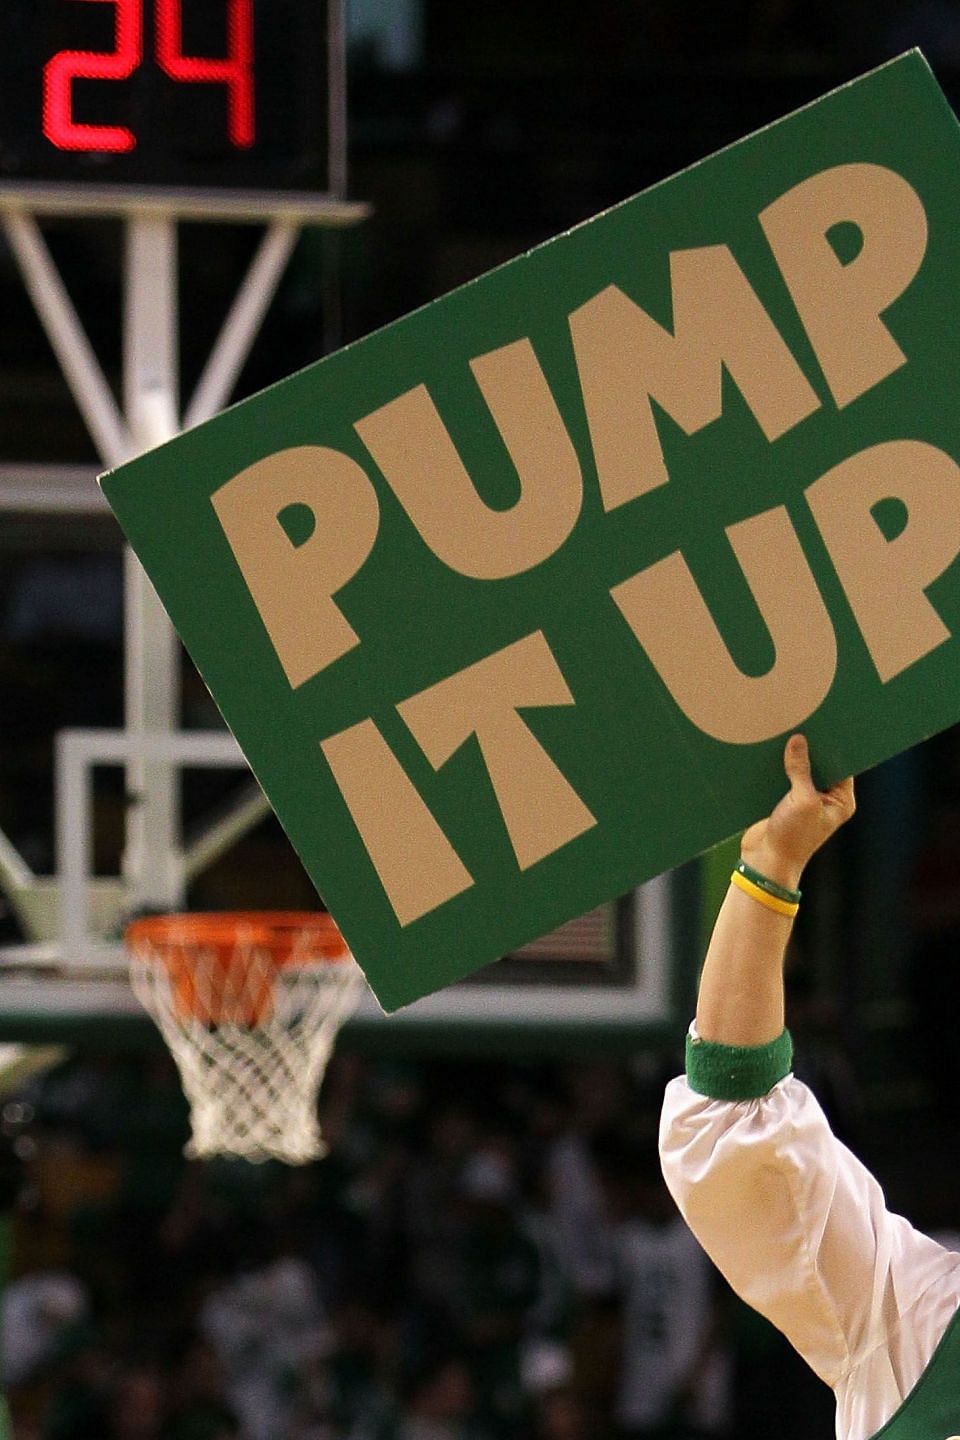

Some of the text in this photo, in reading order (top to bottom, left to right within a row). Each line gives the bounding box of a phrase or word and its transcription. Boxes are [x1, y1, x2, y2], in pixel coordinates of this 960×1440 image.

[42, 0, 255, 154] 24
[211, 164, 928, 689] PUMP
[320, 630, 598, 926] IT
